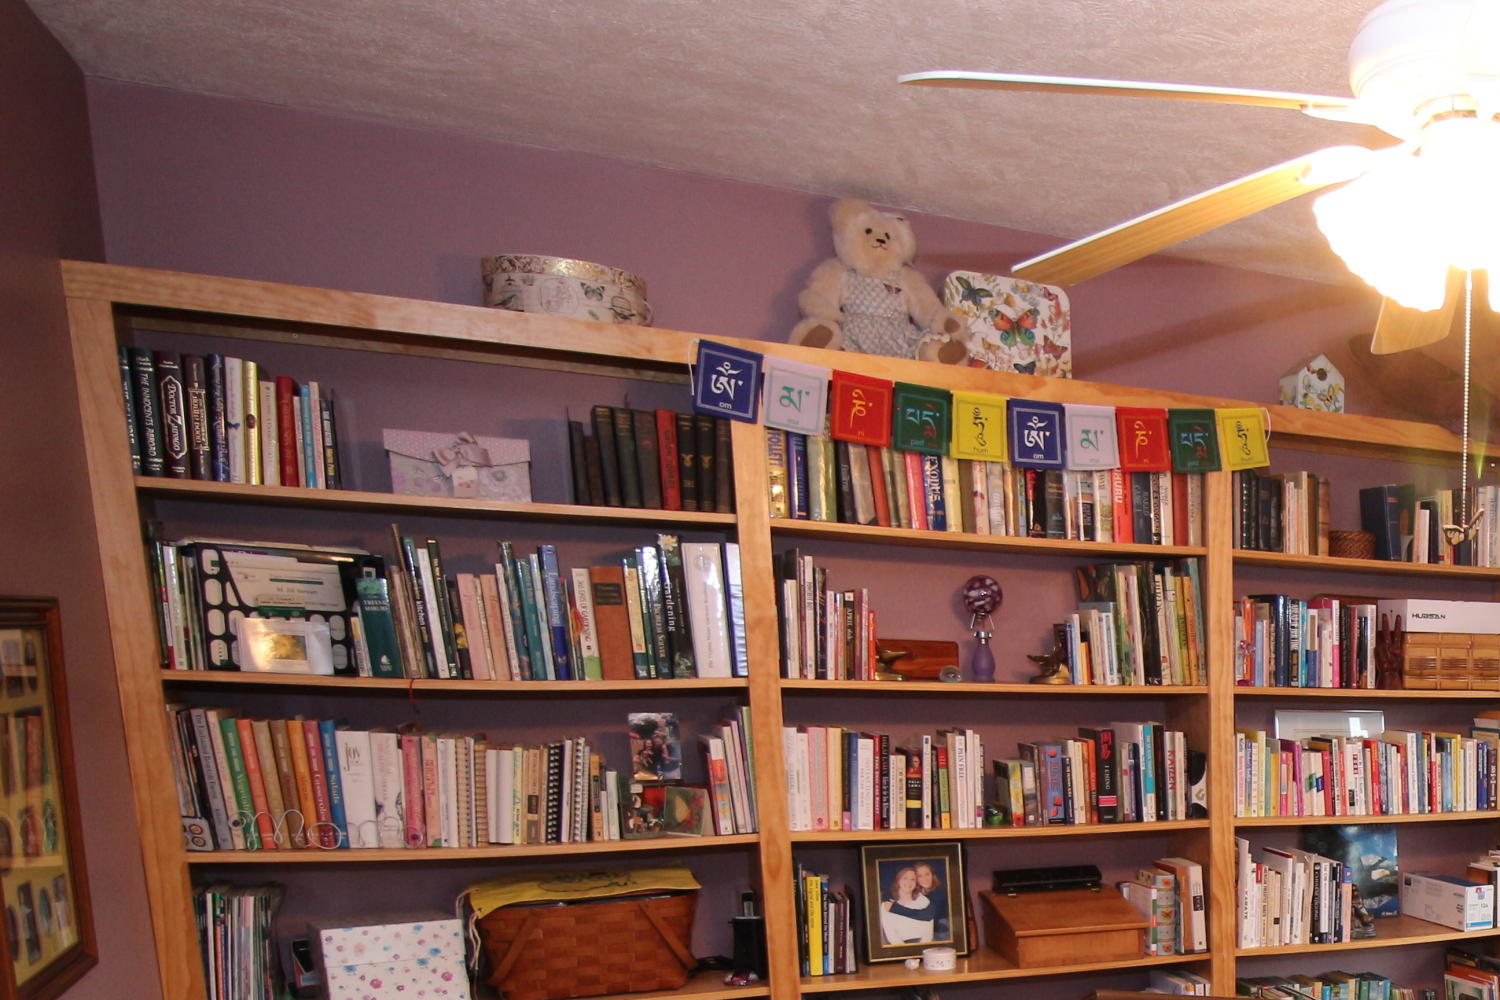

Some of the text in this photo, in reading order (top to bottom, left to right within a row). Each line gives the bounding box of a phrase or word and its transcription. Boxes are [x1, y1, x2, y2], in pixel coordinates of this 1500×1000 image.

[142, 373, 157, 457] THE INNOCENTS ABROAD
[167, 383, 177, 415] DOCTOR
[719, 401, 732, 409] om
[769, 432, 784, 467] FOLLETT
[928, 456, 941, 501] EXODUS
[416, 600, 426, 626] kitchen
[549, 572, 563, 627] Landscaping
[313, 774, 328, 822] Casseroles
[329, 774, 340, 805] Salads
